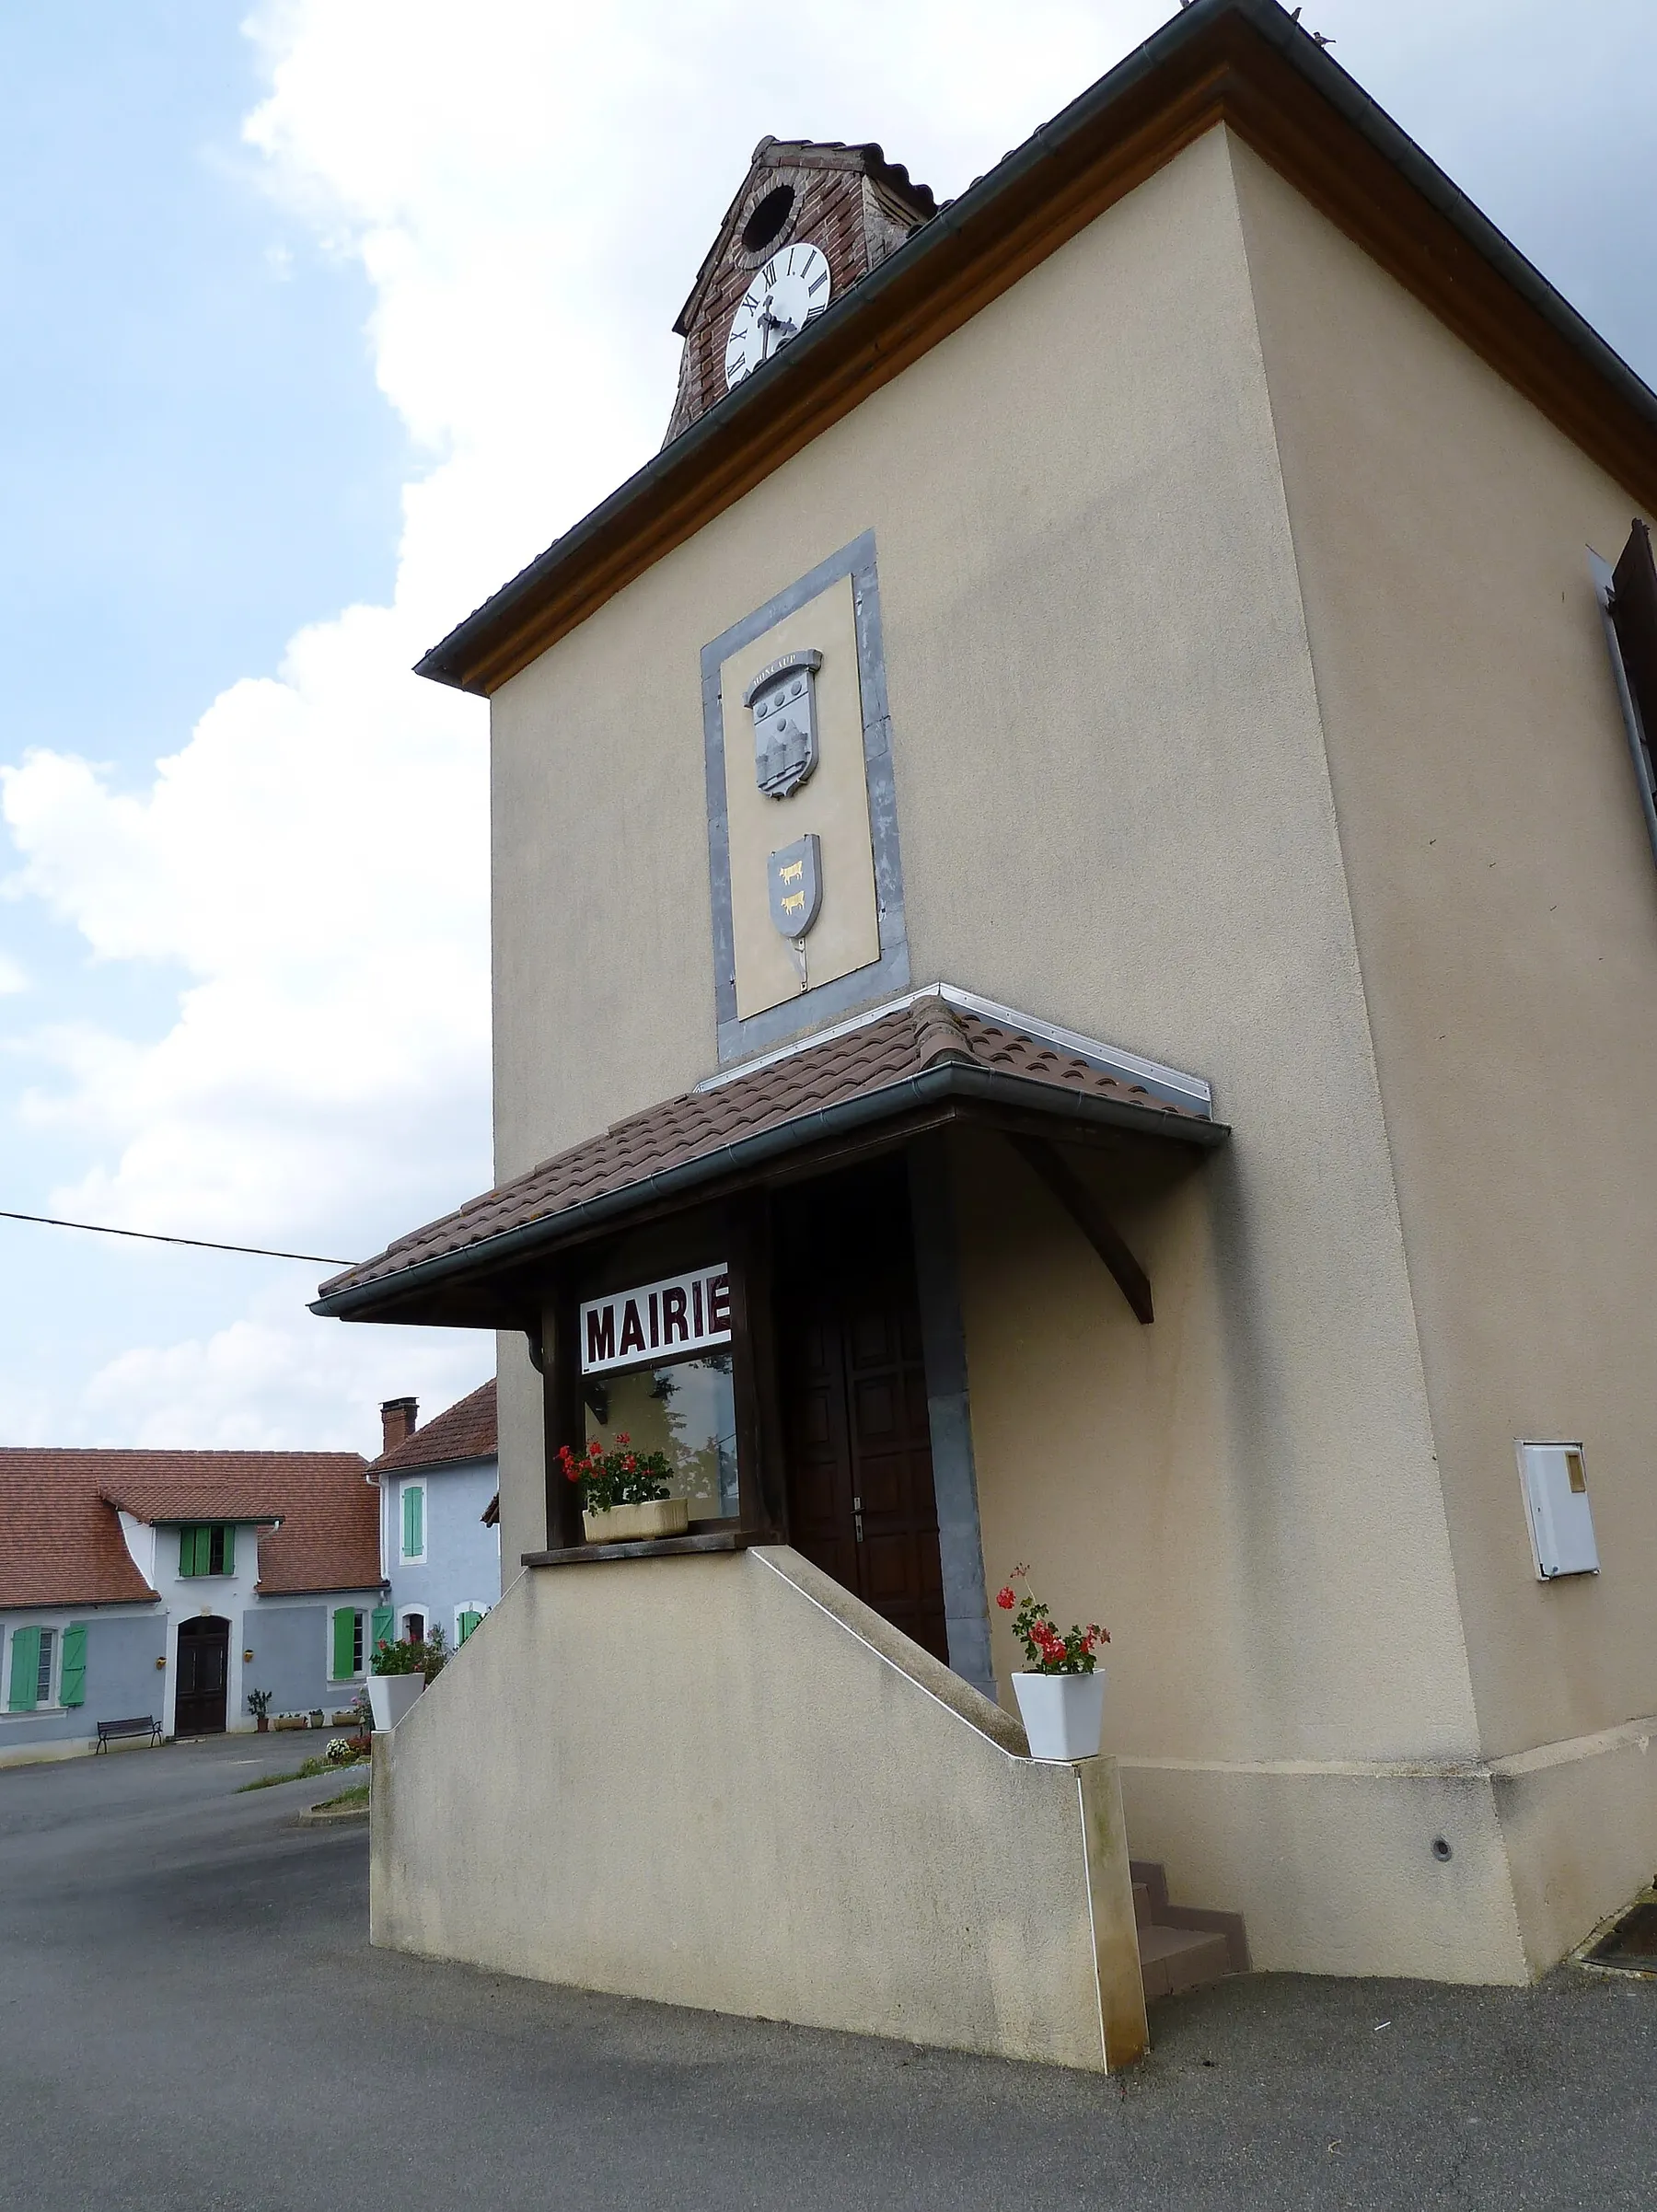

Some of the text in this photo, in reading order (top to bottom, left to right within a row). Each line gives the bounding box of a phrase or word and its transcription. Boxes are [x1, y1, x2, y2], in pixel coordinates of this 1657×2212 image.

[762, 260, 777, 293] XII
[742, 293, 759, 317] XI
[730, 328, 747, 343] X
[586, 1273, 732, 1363] MAIRIE
